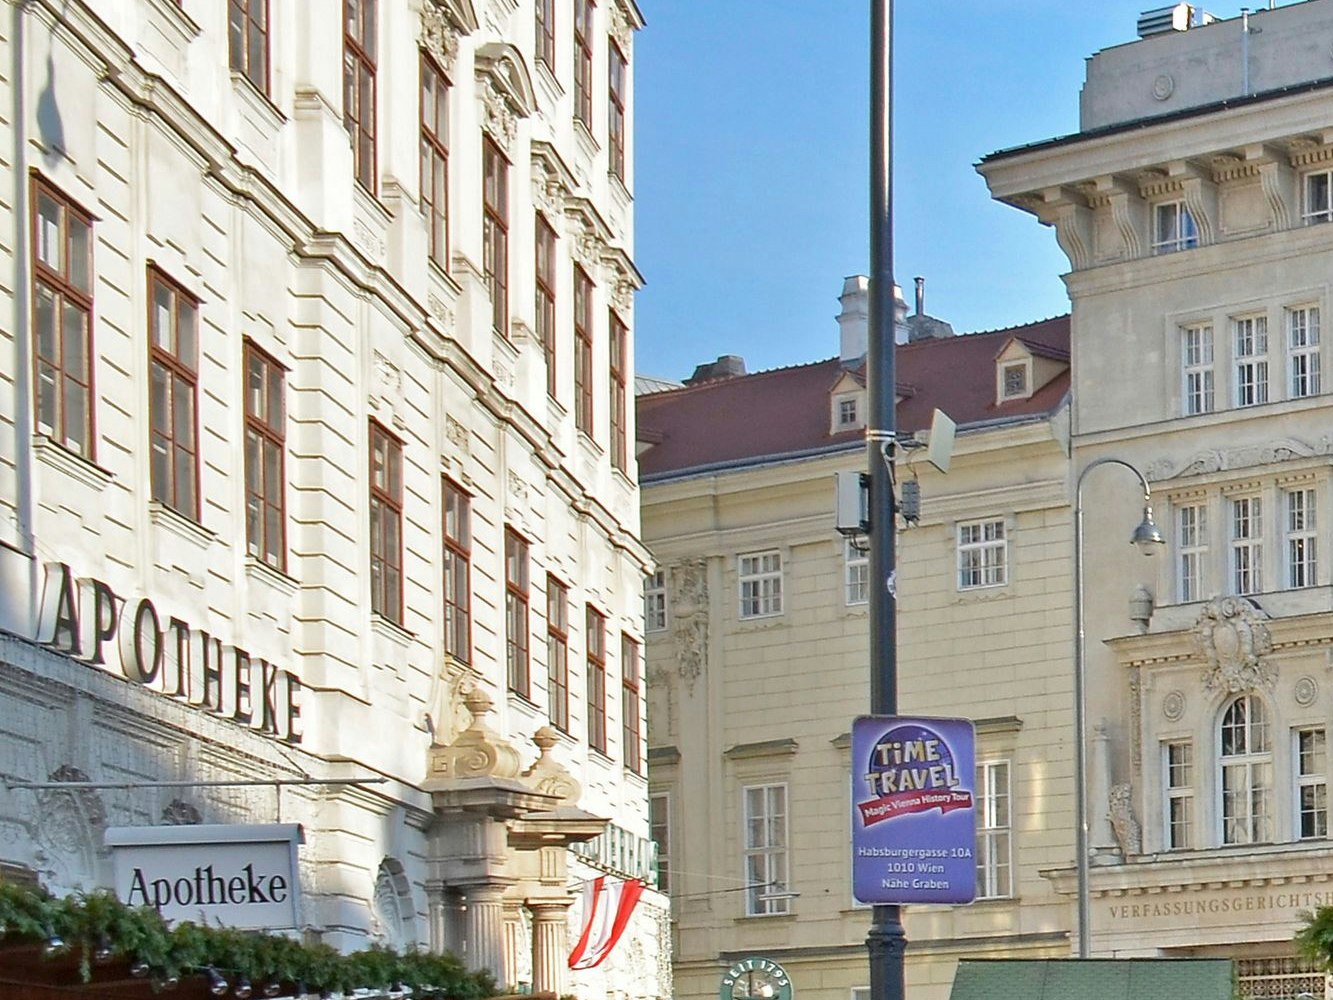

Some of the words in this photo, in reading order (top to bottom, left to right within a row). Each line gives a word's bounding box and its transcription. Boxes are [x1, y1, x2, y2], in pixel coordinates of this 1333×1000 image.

[44, 562, 303, 743] APOTHEKE
[864, 763, 960, 796] TRAVEL
[864, 803, 891, 817] Magic
[892, 798, 921, 809] Vienna
[921, 793, 951, 803] History
[951, 792, 970, 802] Tour
[858, 847, 949, 860] Habsburgergasse
[951, 848, 972, 858] 10A
[887, 863, 915, 873] 1010
[917, 863, 945, 873] Wien
[127, 863, 287, 915] Apotheke
[881, 879, 910, 889] Nähe
[912, 879, 950, 889] Graben
[723, 959, 755, 987] SEIT
[760, 960, 790, 987] 1795
